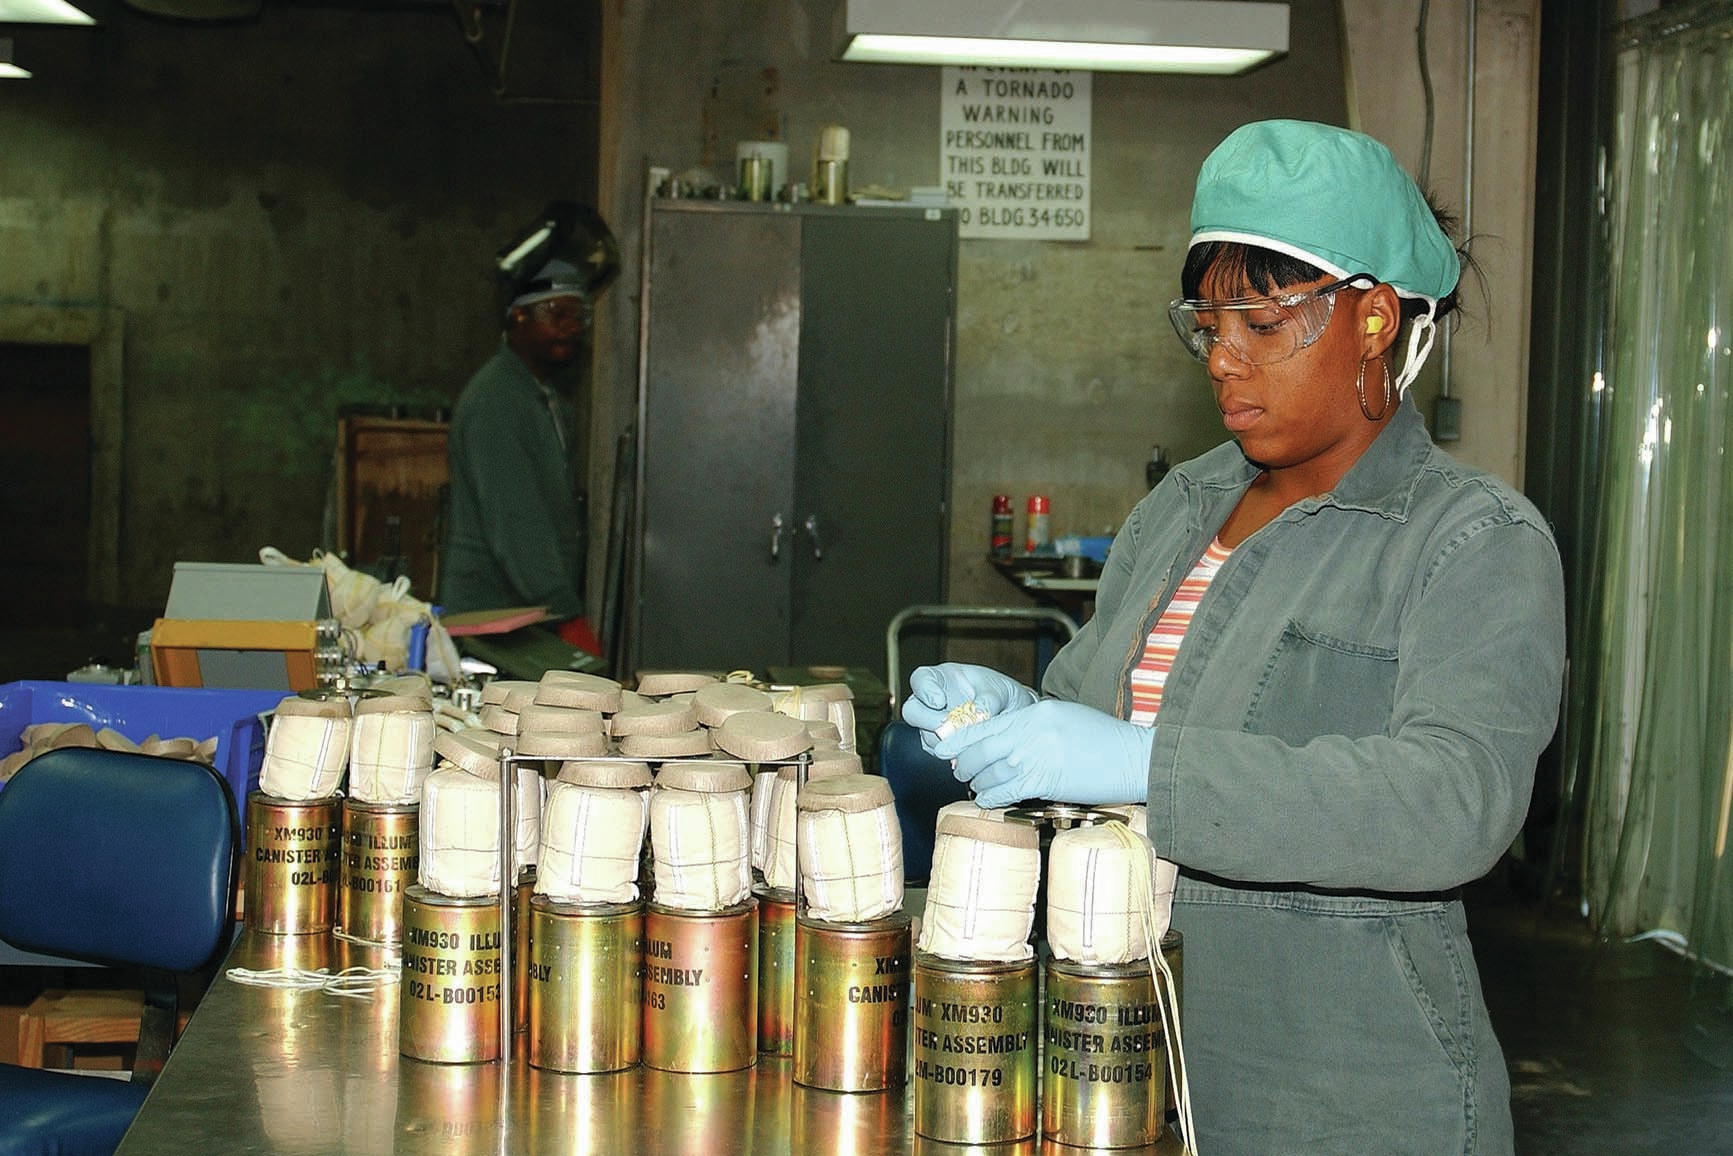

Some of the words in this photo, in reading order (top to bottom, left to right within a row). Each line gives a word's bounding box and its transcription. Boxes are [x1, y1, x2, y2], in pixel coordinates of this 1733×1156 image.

[956, 79, 968, 96] A
[982, 79, 1074, 99] TORNADO
[963, 104, 1054, 125] WARNING
[946, 130, 1032, 150] PERSONNEL
[1042, 133, 1085, 152] FROM
[947, 155, 984, 175] THIS
[991, 156, 1031, 175] BLDG
[1042, 158, 1085, 177] WILL
[947, 180, 966, 199] BE
[976, 181, 1084, 200] TRANSFERRED
[979, 207, 1024, 226] BLDG
[274, 827, 322, 841] XM930
[368, 835, 412, 850] ILLUM
[256, 848, 321, 864] CANISTER
[409, 927, 460, 950] XM930
[941, 1003, 1003, 1024] XM930
[1052, 998, 1107, 1025] XM930
[942, 1031, 1029, 1054] ASSEMBLY
